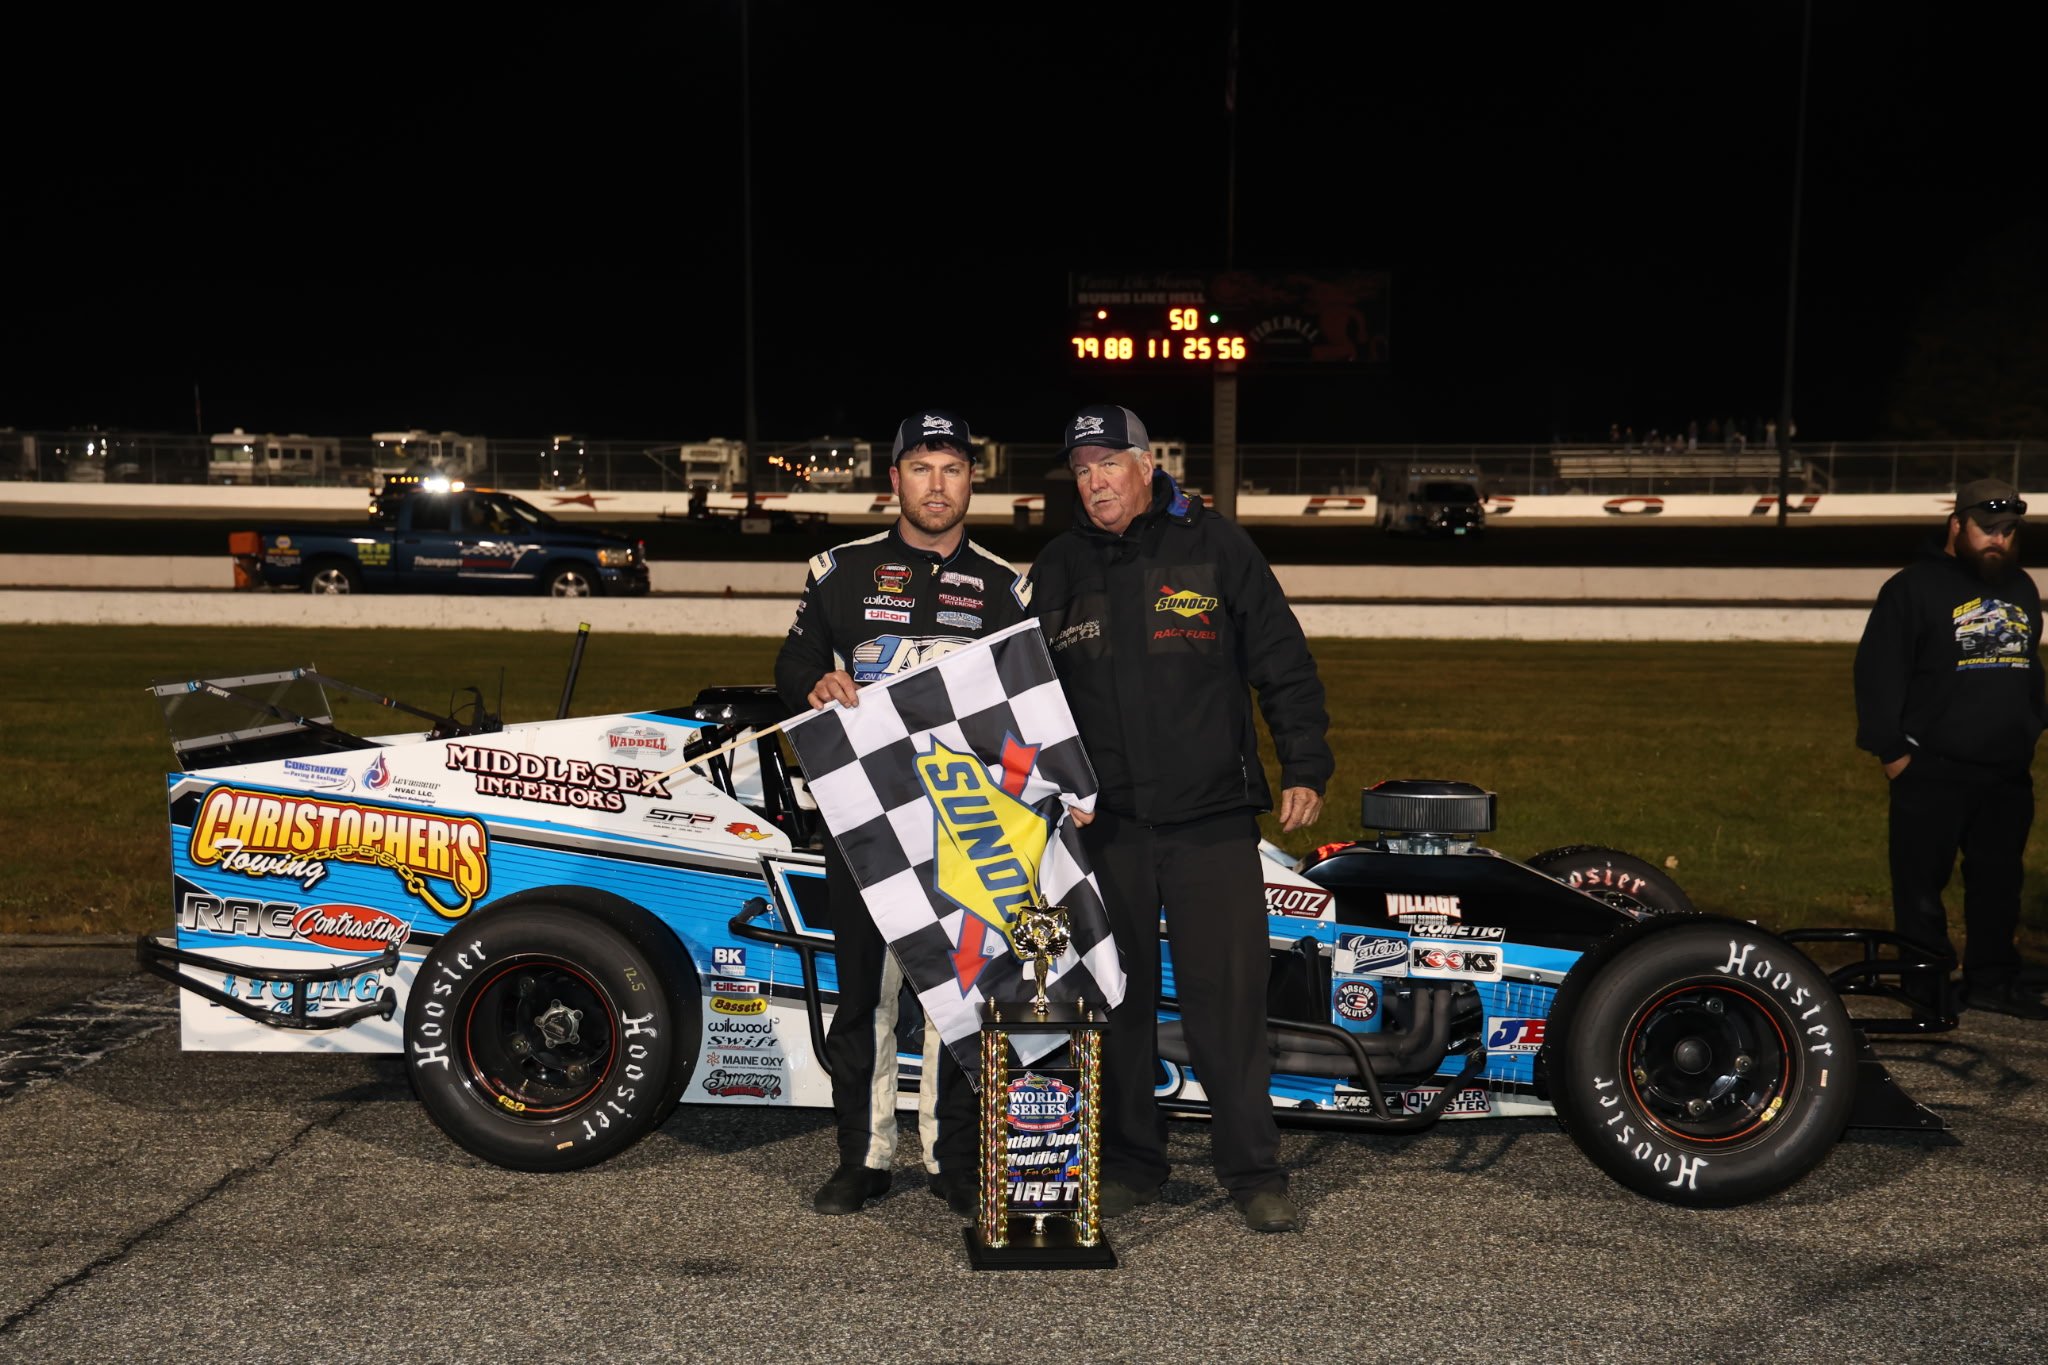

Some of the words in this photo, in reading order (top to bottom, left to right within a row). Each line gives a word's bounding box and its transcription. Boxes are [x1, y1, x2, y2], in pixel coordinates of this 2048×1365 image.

[1133, 292, 1168, 304] LIKE
[1169, 292, 1206, 304] HELL
[1168, 308, 1199, 331] 50
[1250, 315, 1321, 342] FIREBALL
[1072, 337, 1099, 359] 79
[1182, 337, 1212, 360] 25
[1216, 337, 1246, 360] 56
[939, 594, 983, 605] MIDDLESEX
[1158, 599, 1215, 610] SUNOCO
[868, 611, 907, 621] tilton
[1186, 630, 1216, 640] FUELS
[609, 734, 666, 751] WADDELL
[284, 760, 348, 776] CONSTANTINE
[447, 744, 672, 799] MIDDLESEX
[395, 787, 415, 795] HVAC
[476, 774, 625, 812] INTERIORS
[197, 792, 486, 900] CHRISTOPHER'S
[214, 837, 327, 889] Towing
[1265, 887, 1328, 912] KLOTZ
[1384, 892, 1462, 919] VILLAGE
[295, 908, 411, 946] Contracting
[1413, 923, 1505, 938] COMETIC
[714, 948, 742, 964] BK
[1412, 948, 1497, 974] KOOKS
[714, 982, 757, 993] tilton
[1341, 984, 1374, 1000] NASCAR
[413, 940, 487, 1071] Hoosier
[714, 999, 763, 1012] Bassett
[1715, 940, 1834, 1057] Hoosier
[1338, 1002, 1372, 1017] SALUTES
[707, 1018, 772, 1034] wilwood
[722, 1055, 758, 1066] MAINE
[760, 1056, 784, 1067] OXY
[582, 1010, 657, 1140] Hoosier
[1009, 1091, 1068, 1103] WORLD
[1011, 1103, 1066, 1116] SERIES
[1594, 1076, 1709, 1190] Hoosier
[1006, 1181, 1080, 1202] FIRST
